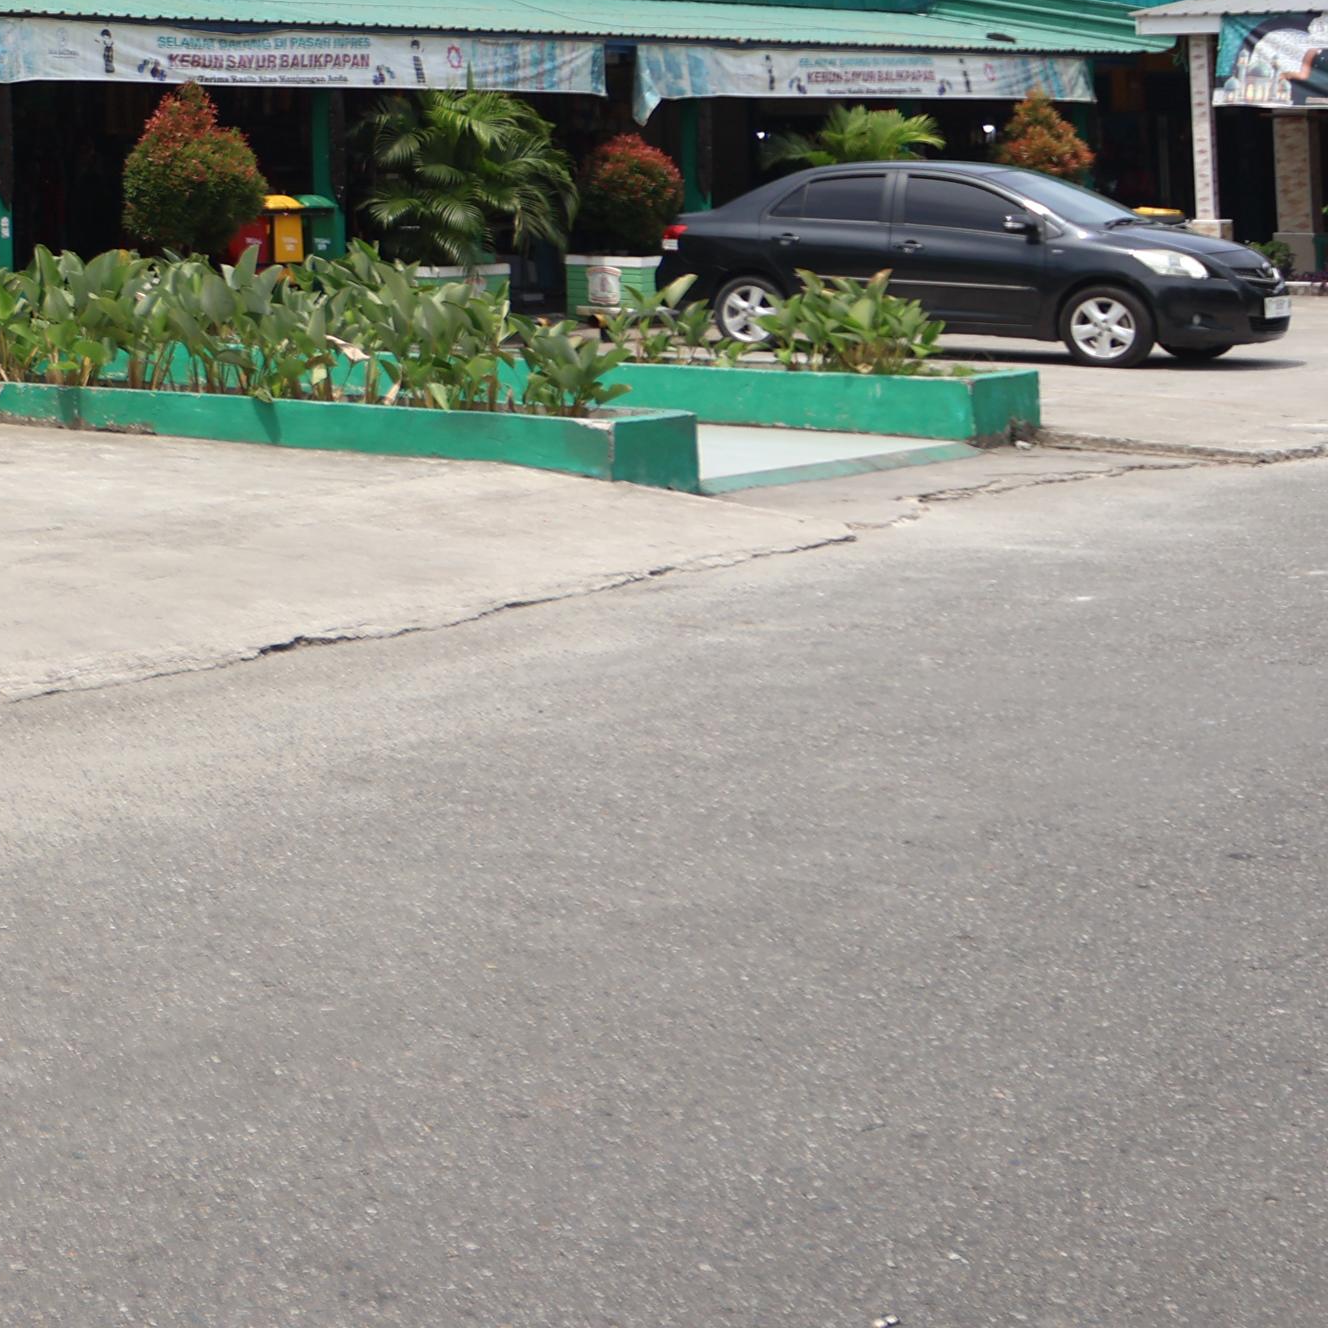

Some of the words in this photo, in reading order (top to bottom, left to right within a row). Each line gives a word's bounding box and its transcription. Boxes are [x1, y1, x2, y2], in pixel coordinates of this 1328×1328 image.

[168, 53, 223, 69] KEBUN
[226, 54, 277, 70] SAYUR
[279, 53, 370, 69] BALIKPAPAN
